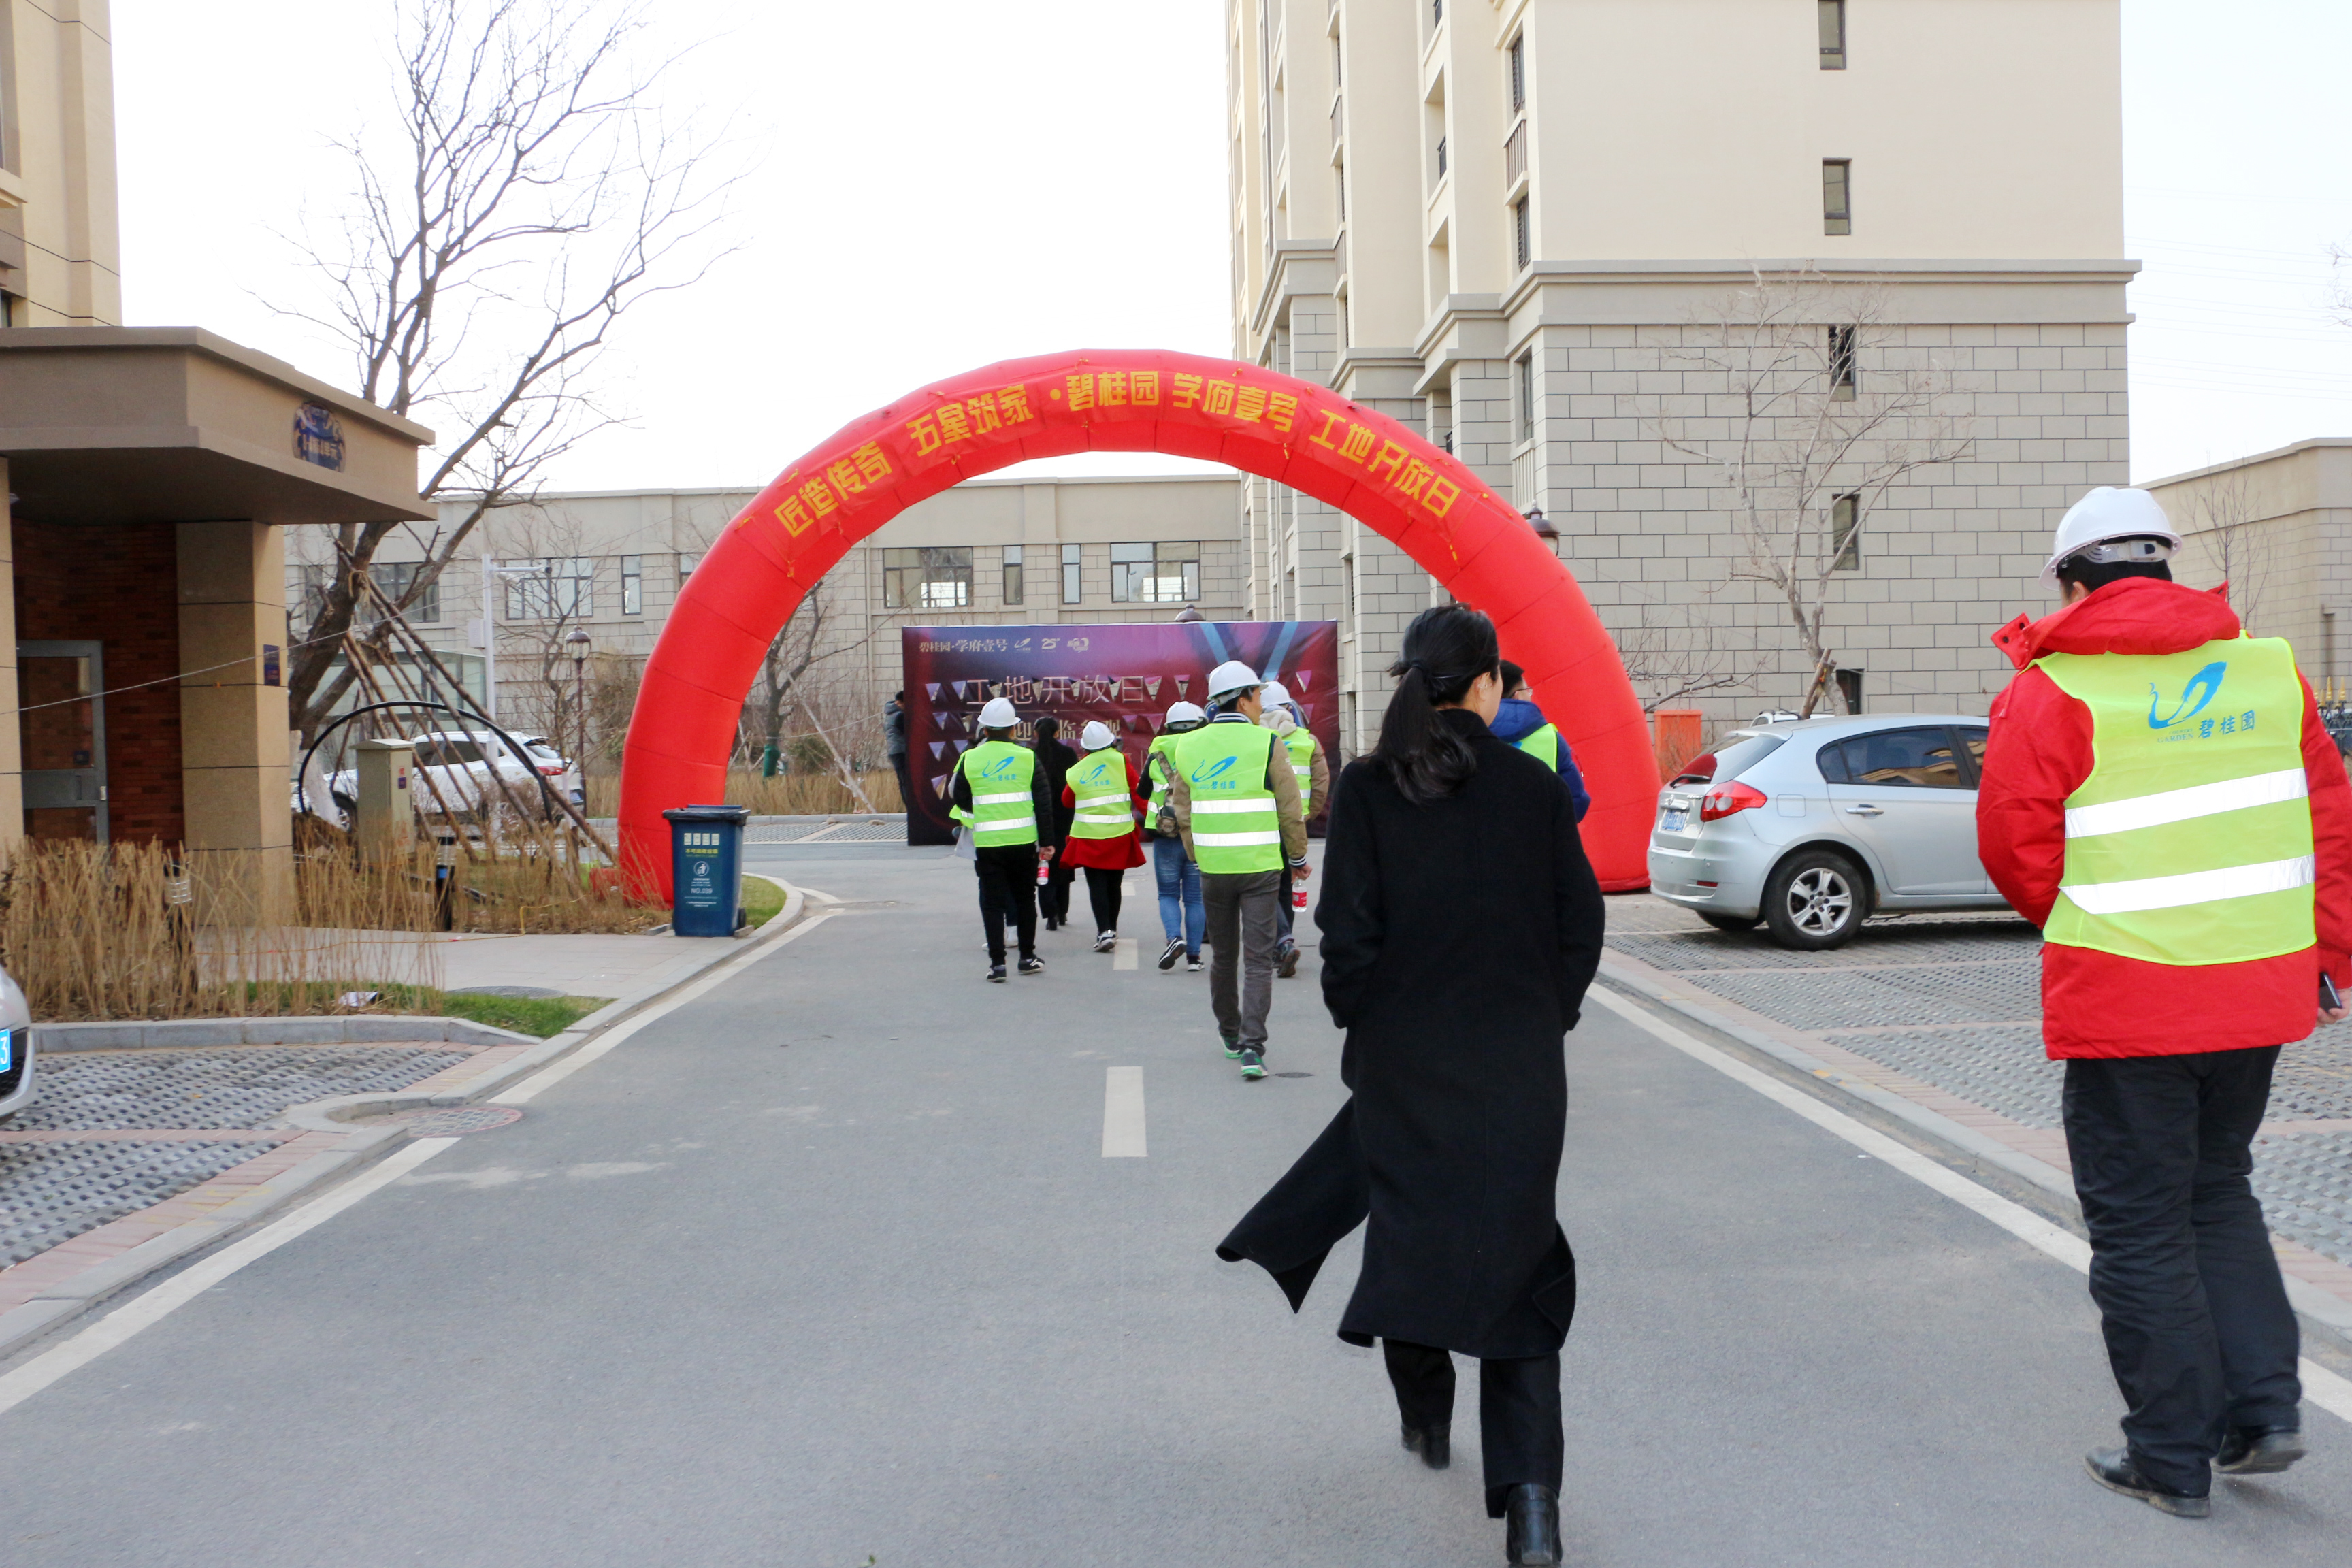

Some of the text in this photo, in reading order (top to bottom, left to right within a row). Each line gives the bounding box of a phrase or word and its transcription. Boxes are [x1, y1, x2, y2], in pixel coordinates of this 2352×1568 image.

[773, 440, 892, 538] 匠造传奇
[906, 383, 1034, 457] 五星筑家
[1172, 372, 1299, 433] 学府壹号
[1308, 408, 1461, 519] 工地开放日
[966, 674, 1144, 704] 工地开放日
[2157, 733, 2194, 743] GARDEN
